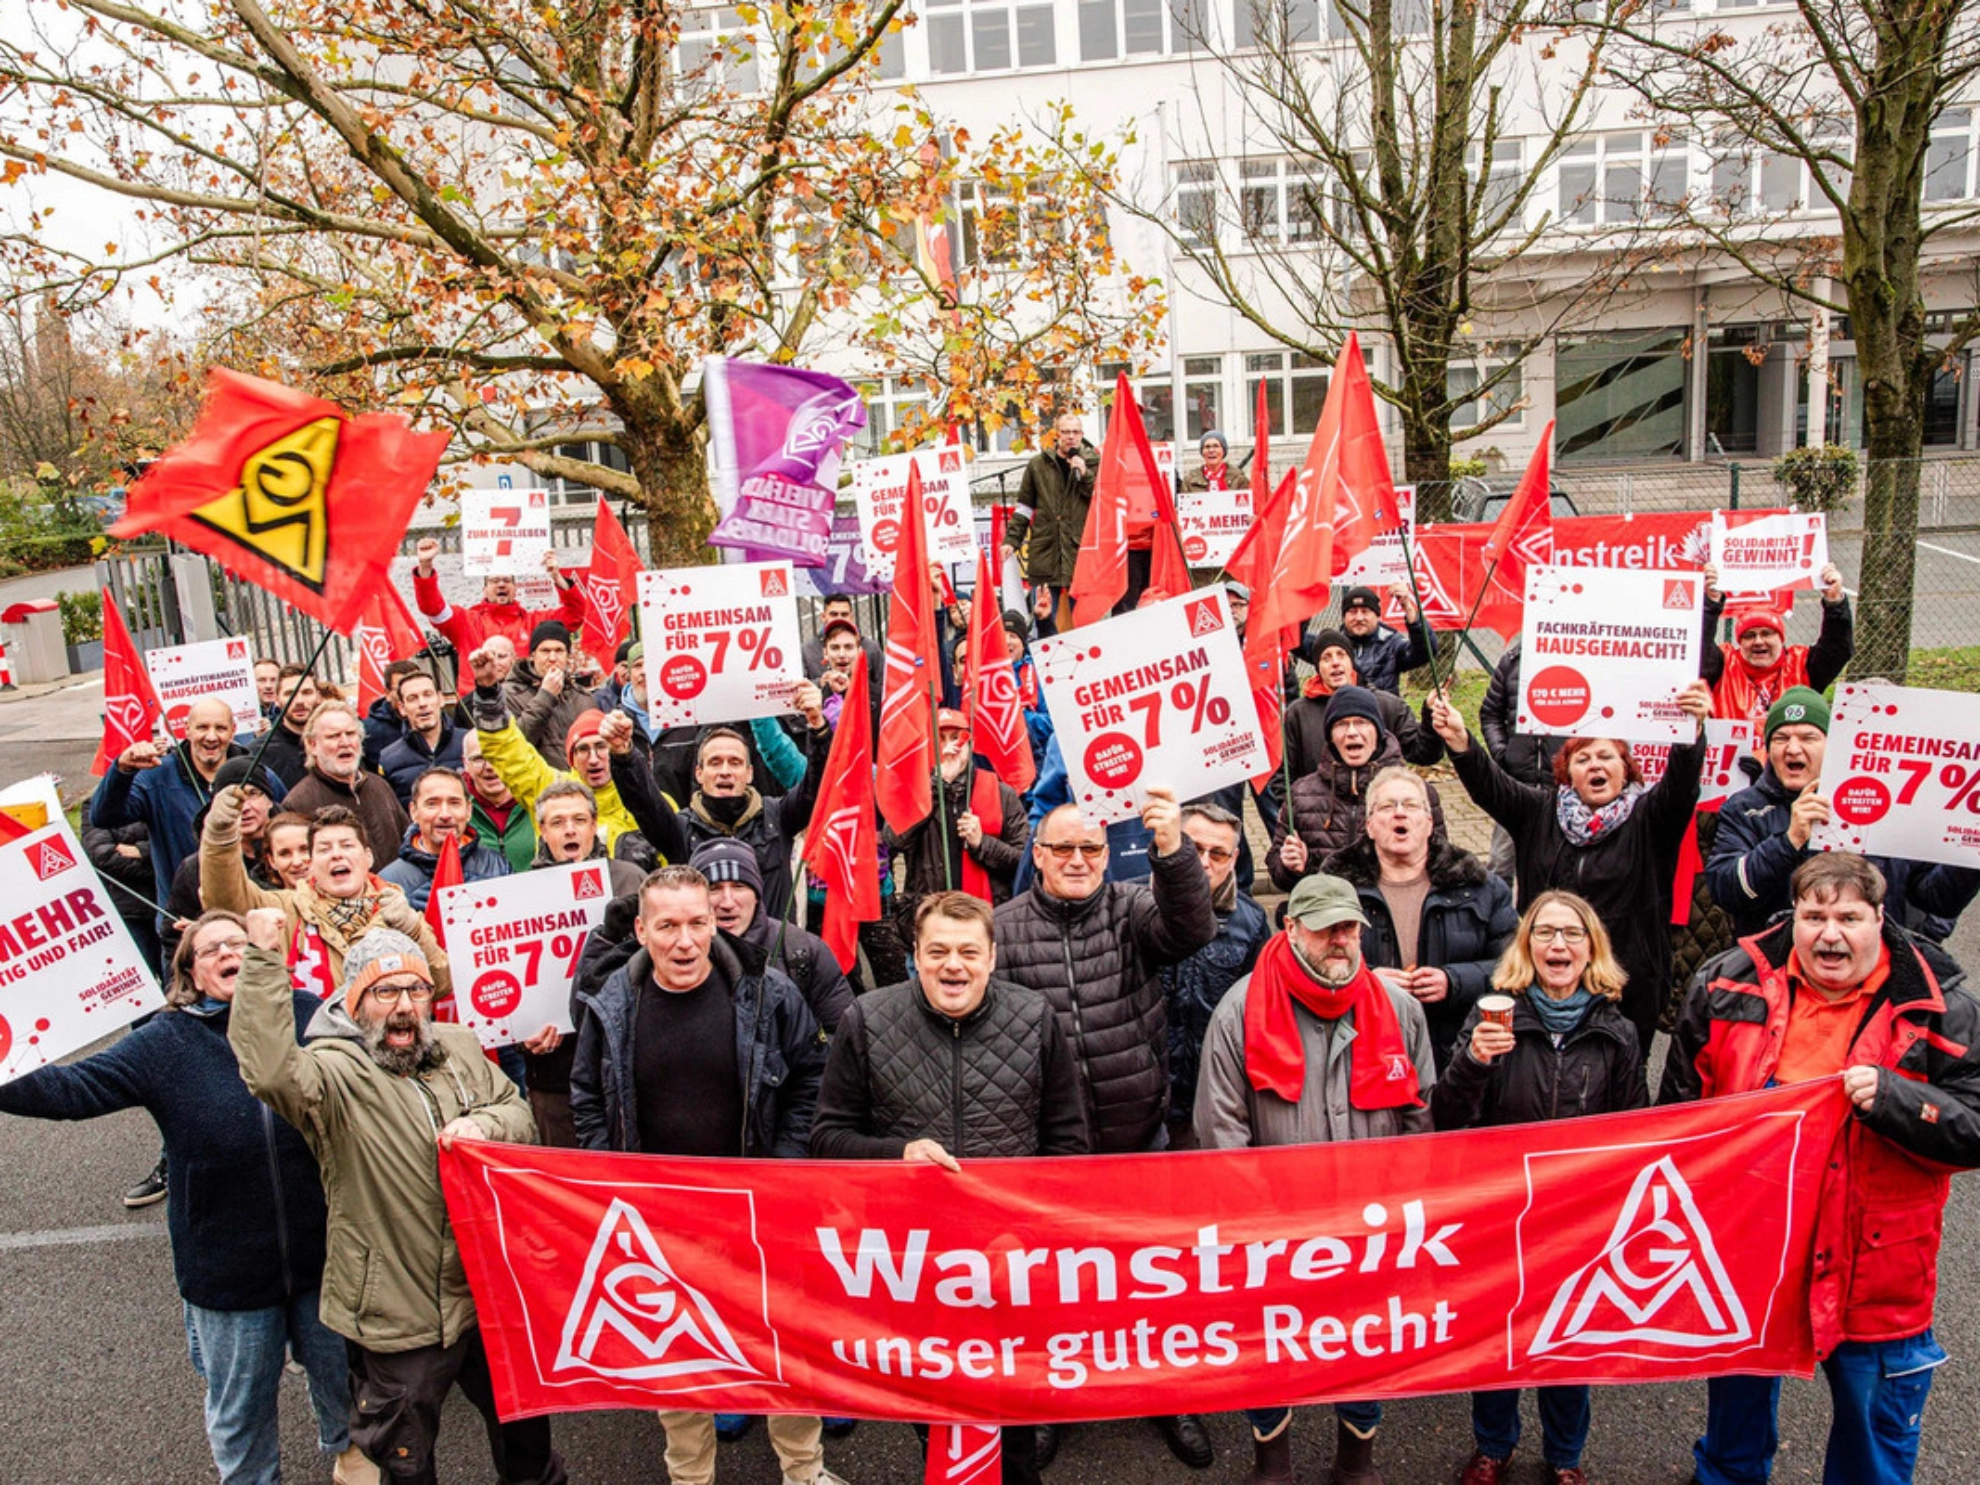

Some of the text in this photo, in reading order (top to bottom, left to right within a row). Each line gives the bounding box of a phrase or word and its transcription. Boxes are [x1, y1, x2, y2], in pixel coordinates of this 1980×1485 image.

[871, 479, 949, 502] GEMESAM
[873, 501, 897, 517] FÜR
[467, 529, 488, 539] ZUM
[1724, 534, 1800, 548] SOLIDARITÄT
[1554, 535, 1678, 568] nstreik
[663, 605, 773, 630] GEMEINSAM
[665, 631, 699, 651] FÜR
[1536, 621, 1688, 641] FACHKRÄFTEMANGEL?!
[1535, 636, 1687, 660] HAUSGEMACHT!
[162, 677, 249, 700] HAUSGEMACHT!
[1074, 647, 1210, 707] GEMEINSAM
[1080, 703, 1125, 732] FÜR
[1095, 744, 1125, 761] DAFÜR
[1219, 739, 1255, 759] GEWINNT
[1093, 750, 1134, 773] STREITEN
[1849, 751, 1892, 773] FÜR
[1841, 797, 1882, 806] STREITEN
[470, 908, 588, 947] GEMEINSAM
[26, 944, 66, 972] UND
[66, 920, 114, 953] FAIR!
[473, 945, 510, 969] FÜR
[78, 966, 138, 1002] SOLIDARITÄT
[100, 975, 143, 1000] GEWINNT
[816, 1200, 1464, 1309] Warnstreik
[831, 1296, 1458, 1389] unser gutes Recht
